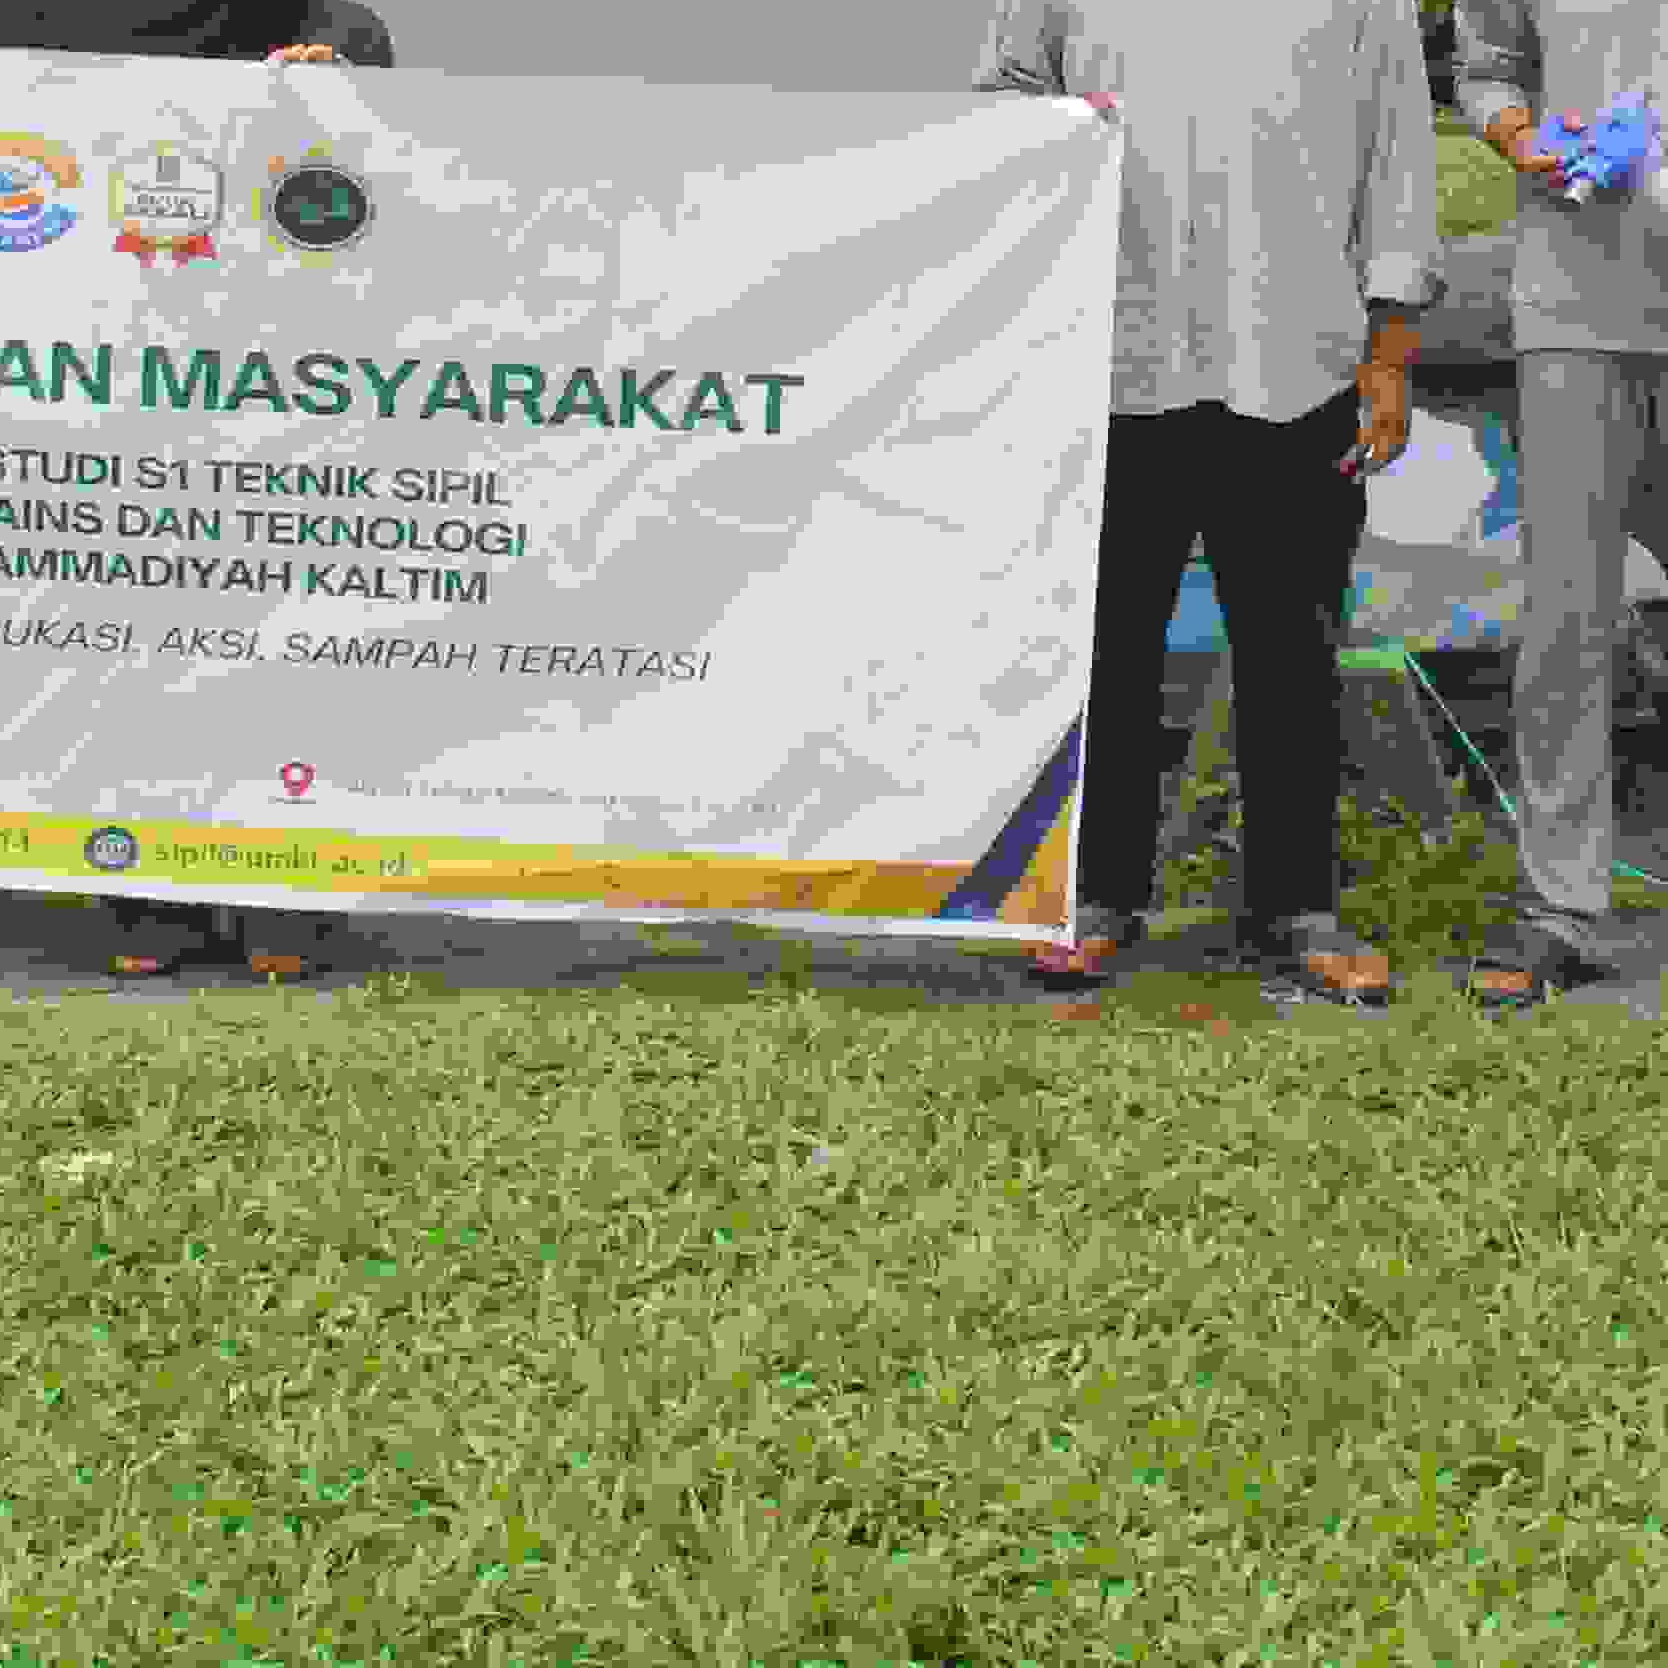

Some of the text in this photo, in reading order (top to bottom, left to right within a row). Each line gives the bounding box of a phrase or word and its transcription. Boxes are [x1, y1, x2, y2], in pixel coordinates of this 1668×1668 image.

[139, 344, 804, 435] MASYARAKAT
[136, 456, 190, 491] S1
[204, 460, 378, 500] TEKNIK
[390, 468, 512, 508] SIPIL
[116, 503, 222, 542] DAN
[236, 510, 528, 558] TEKNOLOGI
[304, 562, 490, 605] KALTIM
[282, 632, 480, 674] SAMPAH
[494, 642, 714, 682] TERATASI
